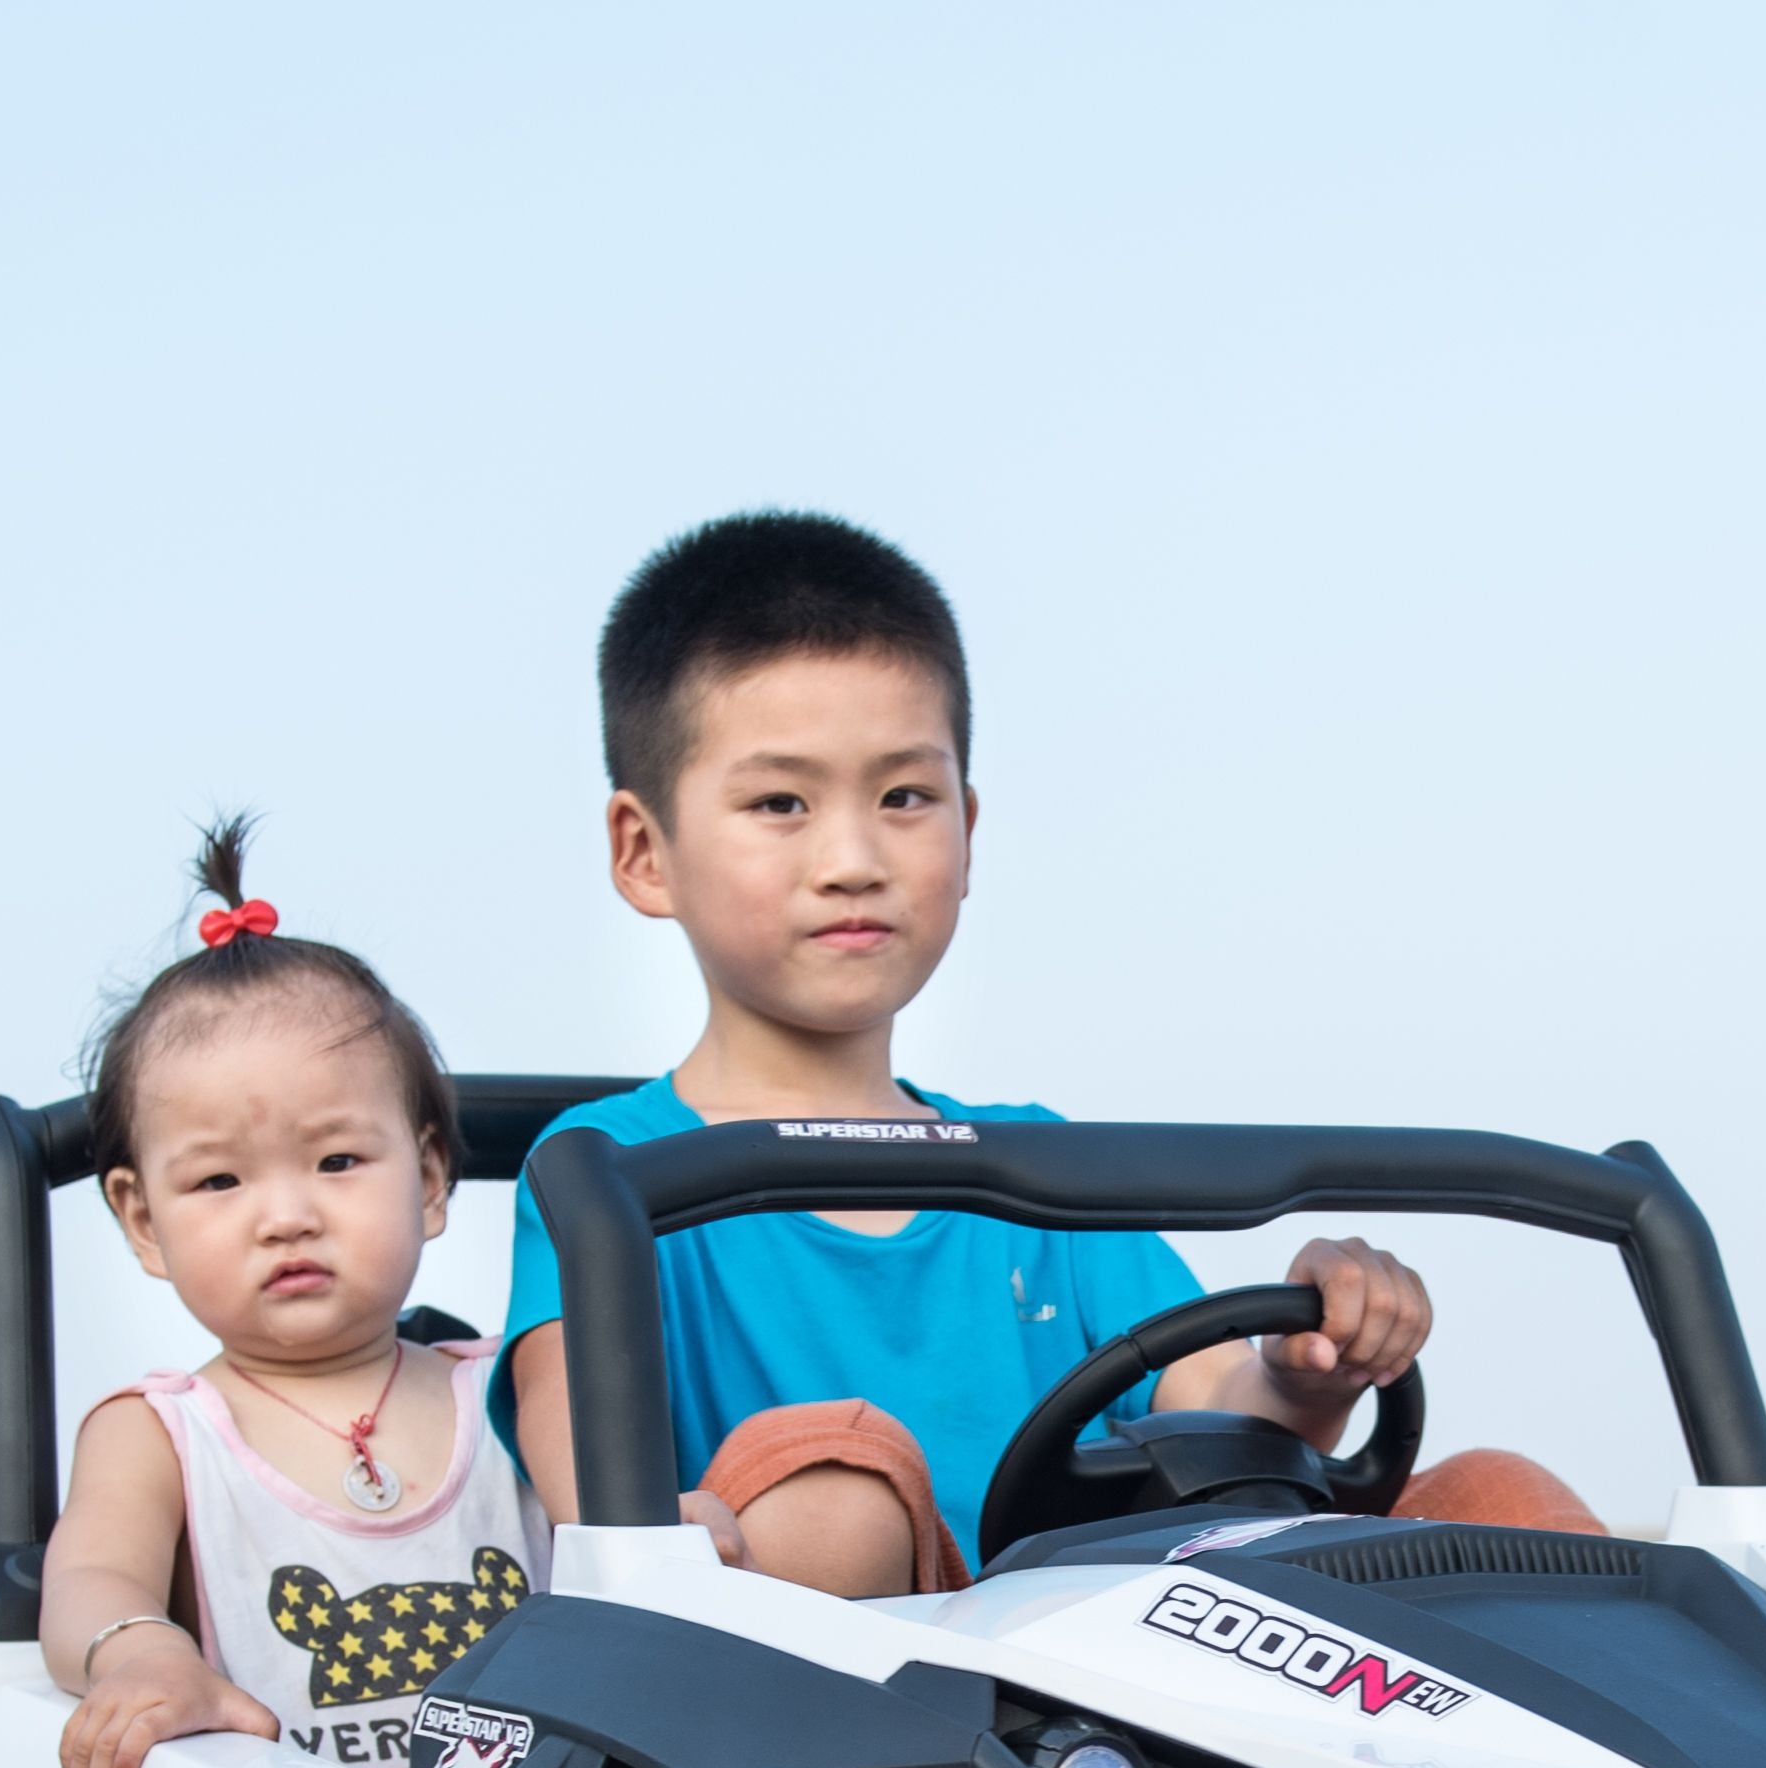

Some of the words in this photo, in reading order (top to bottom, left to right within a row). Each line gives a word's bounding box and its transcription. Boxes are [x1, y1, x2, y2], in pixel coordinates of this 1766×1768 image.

[777, 1123, 928, 1140] SUPERSTAR
[935, 1125, 973, 1140] V2
[505, 1723, 528, 1748] V2
